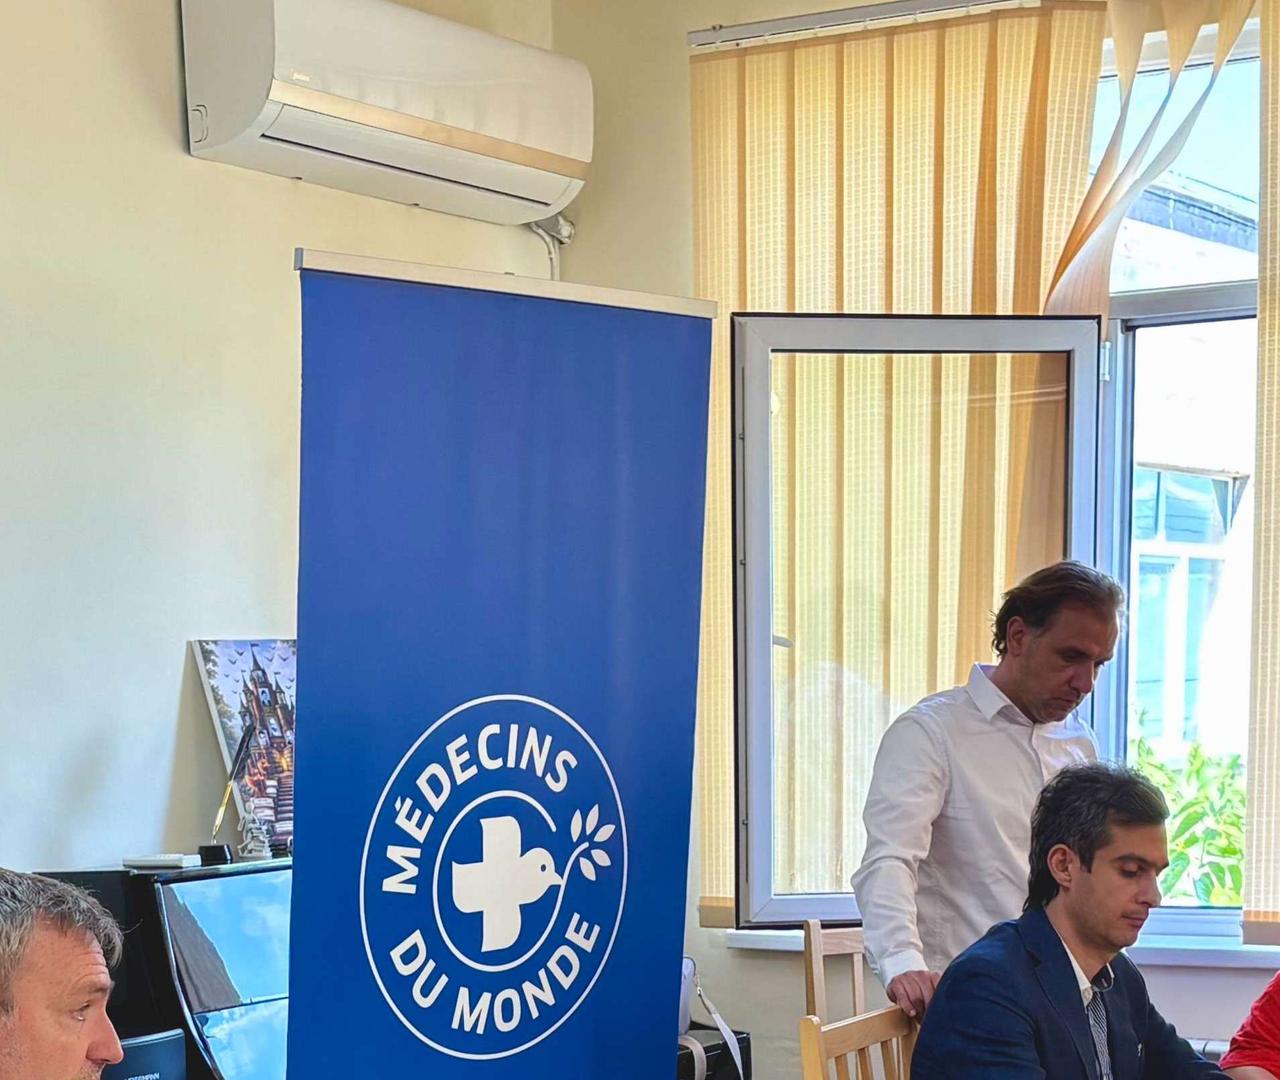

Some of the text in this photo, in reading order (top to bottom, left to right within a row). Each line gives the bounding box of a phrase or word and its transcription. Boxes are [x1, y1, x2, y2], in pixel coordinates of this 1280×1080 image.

[382, 723, 578, 895] MÉDECINS
[389, 912, 601, 1035] DU MONDE
